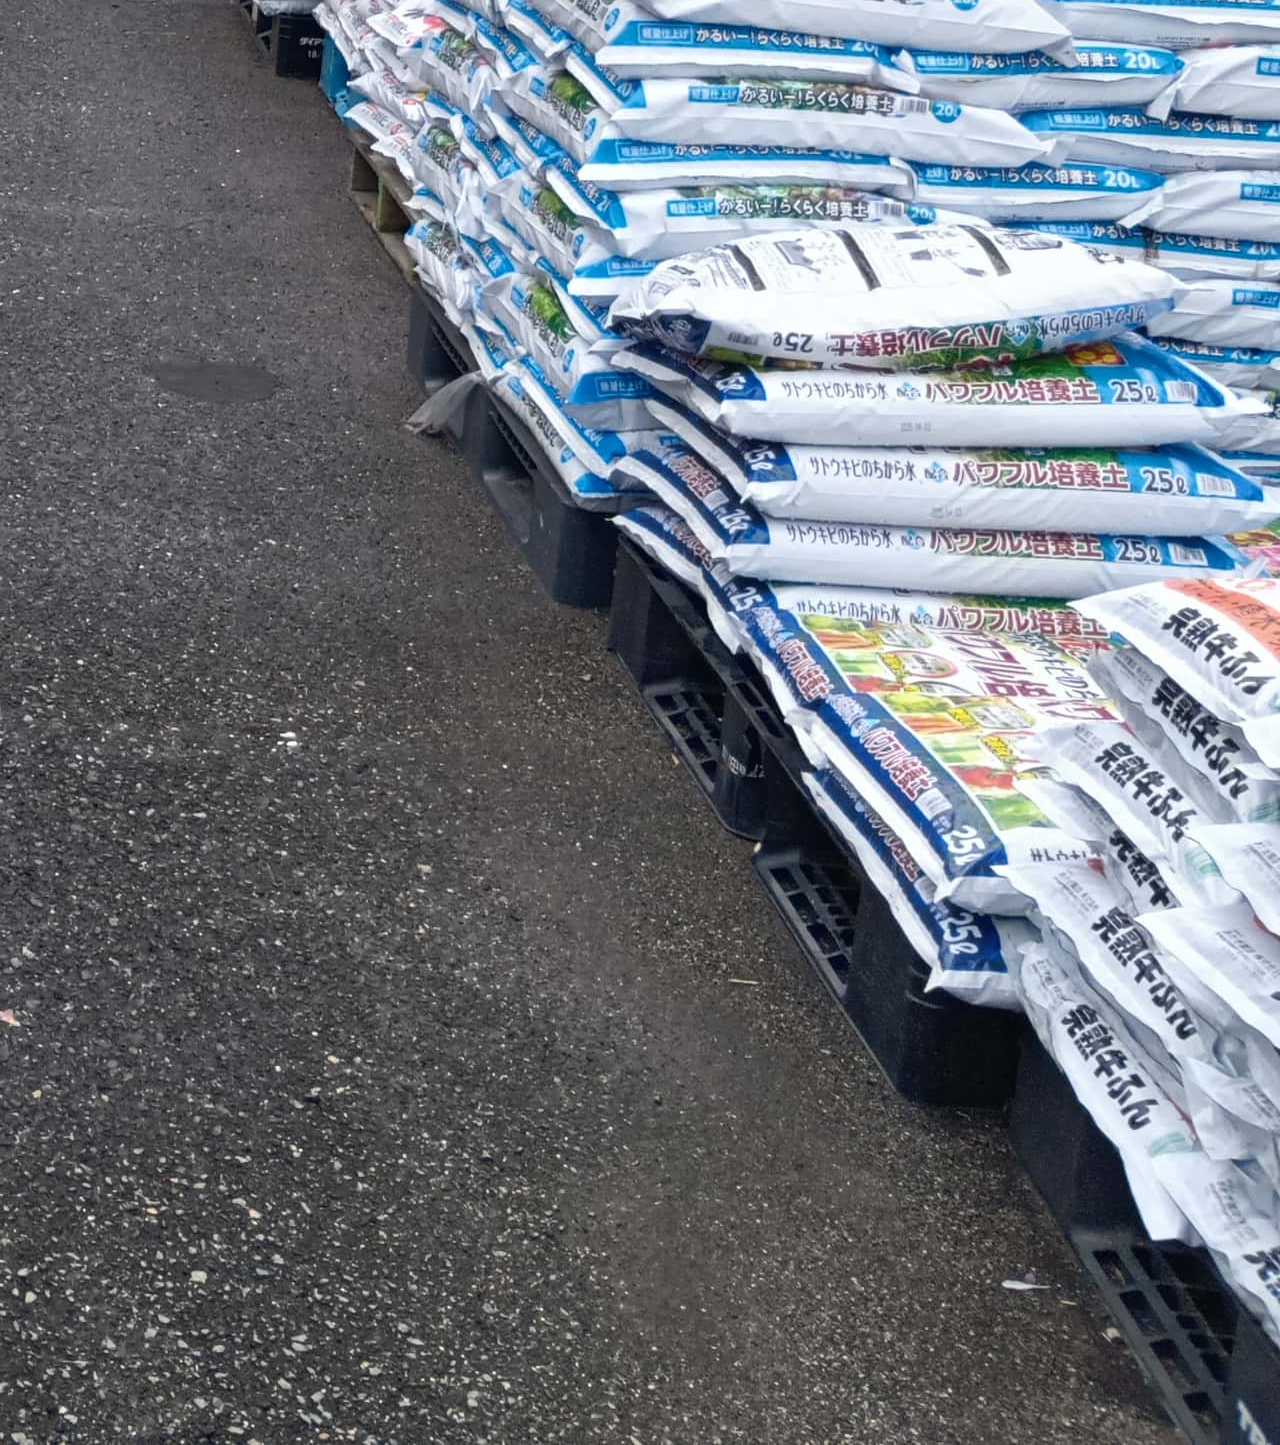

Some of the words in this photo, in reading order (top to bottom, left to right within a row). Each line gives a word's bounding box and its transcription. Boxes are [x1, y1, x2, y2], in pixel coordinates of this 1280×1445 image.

[695, 27, 846, 52] かるいー!らくらく培養土
[1123, 51, 1164, 71] 20L
[742, 85, 894, 115] かるいー!らくらく培養土
[949, 166, 1100, 186] かるいー!らくらく培養土
[1103, 169, 1140, 188] 20L
[719, 199, 869, 220] かるいー!らくらく培養土
[781, 380, 888, 401] サトウキビのちから水
[924, 378, 1100, 404] パワフル培養土
[809, 457, 917, 481] サトウキビのちから水
[951, 461, 1132, 491] パワフル培養土
[786, 524, 894, 548] サトウキビのちから水
[929, 528, 1104, 560] パワフル培養土
[938, 604, 1110, 638] パワフル培養土
[1161, 606, 1276, 696] 完熟牛ふん
[1151, 674, 1250, 800] 完熟牛ふん
[1094, 741, 1198, 844] 完熟牛ふん
[1090, 906, 1198, 1041] 完熟牛ふん
[1060, 1003, 1160, 1131] 完熟牛ふん
